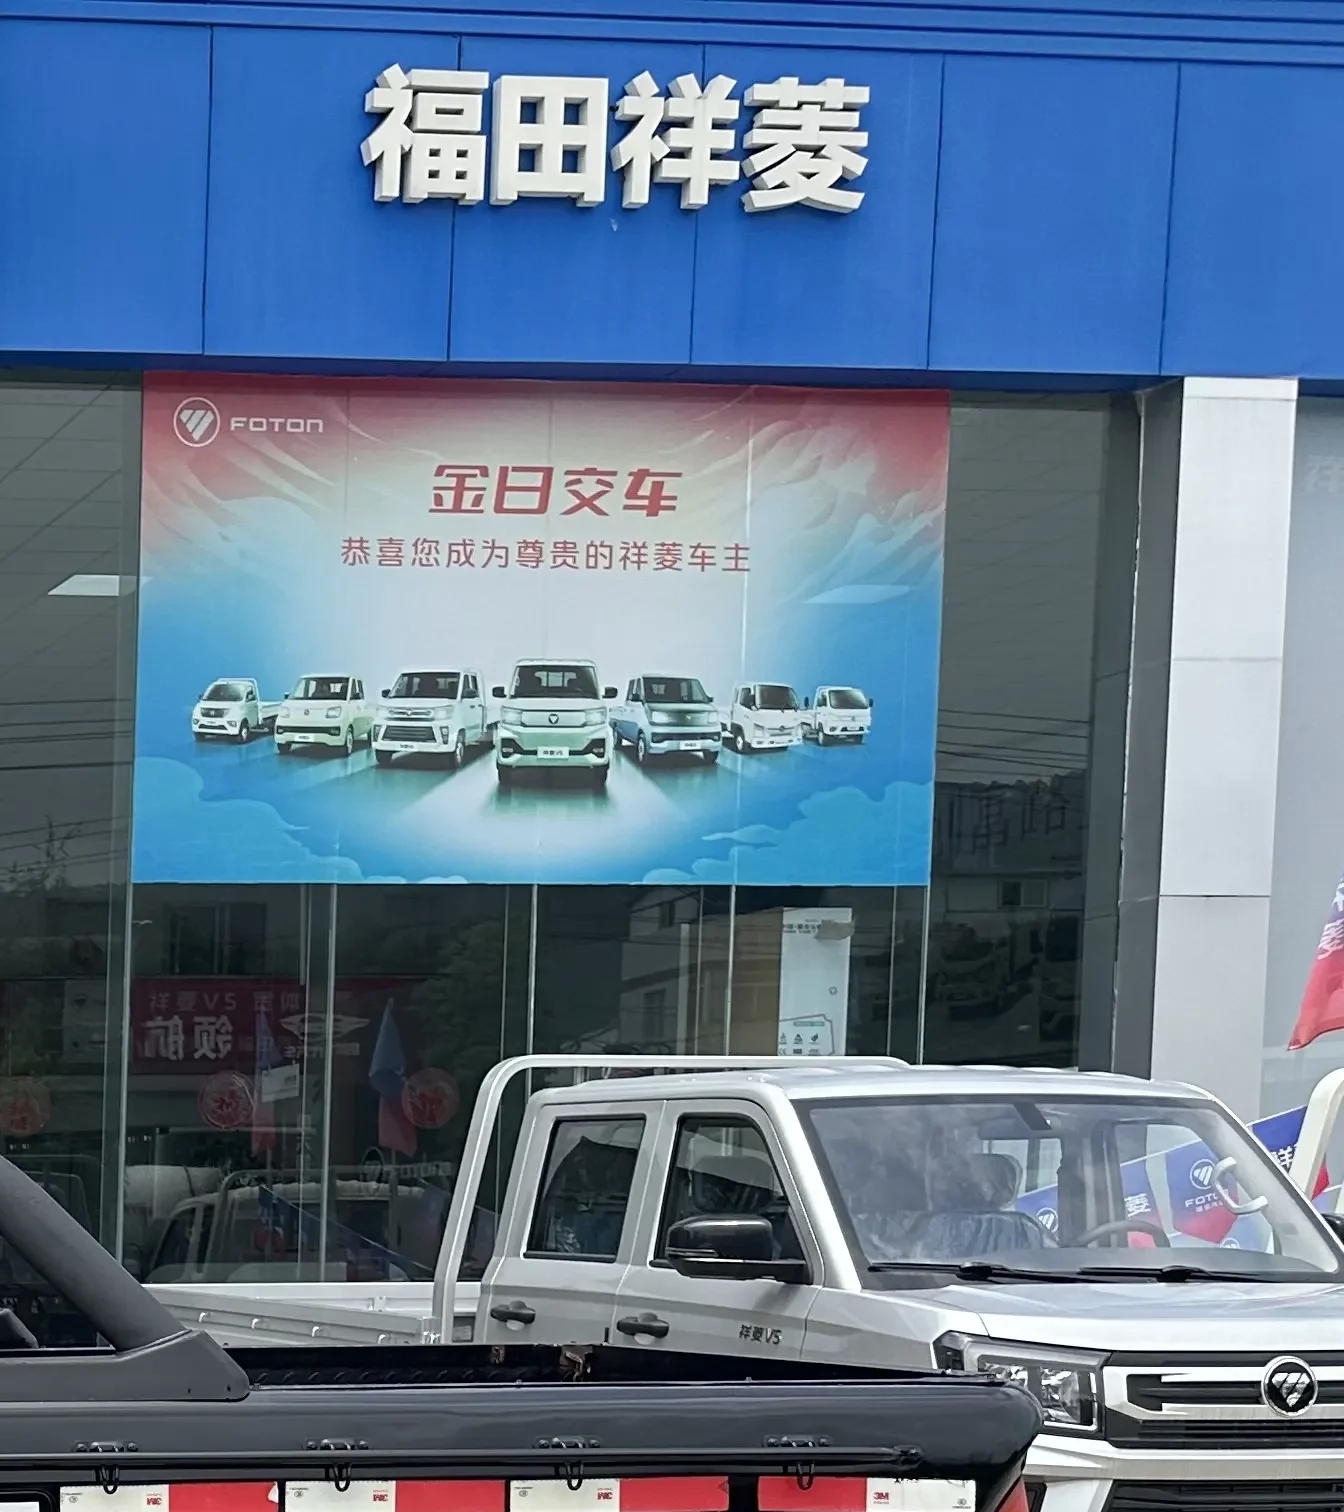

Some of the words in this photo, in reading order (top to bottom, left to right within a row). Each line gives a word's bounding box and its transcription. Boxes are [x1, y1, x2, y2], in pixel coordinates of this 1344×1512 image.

[361, 63, 870, 214] 福田祥菱
[230, 417, 324, 433] FOTON
[429, 464, 683, 517] 金日交车
[340, 536, 751, 573] 恭喜您成为尊贵的祥菱车主
[738, 1323, 783, 1345] 祥菱V5
